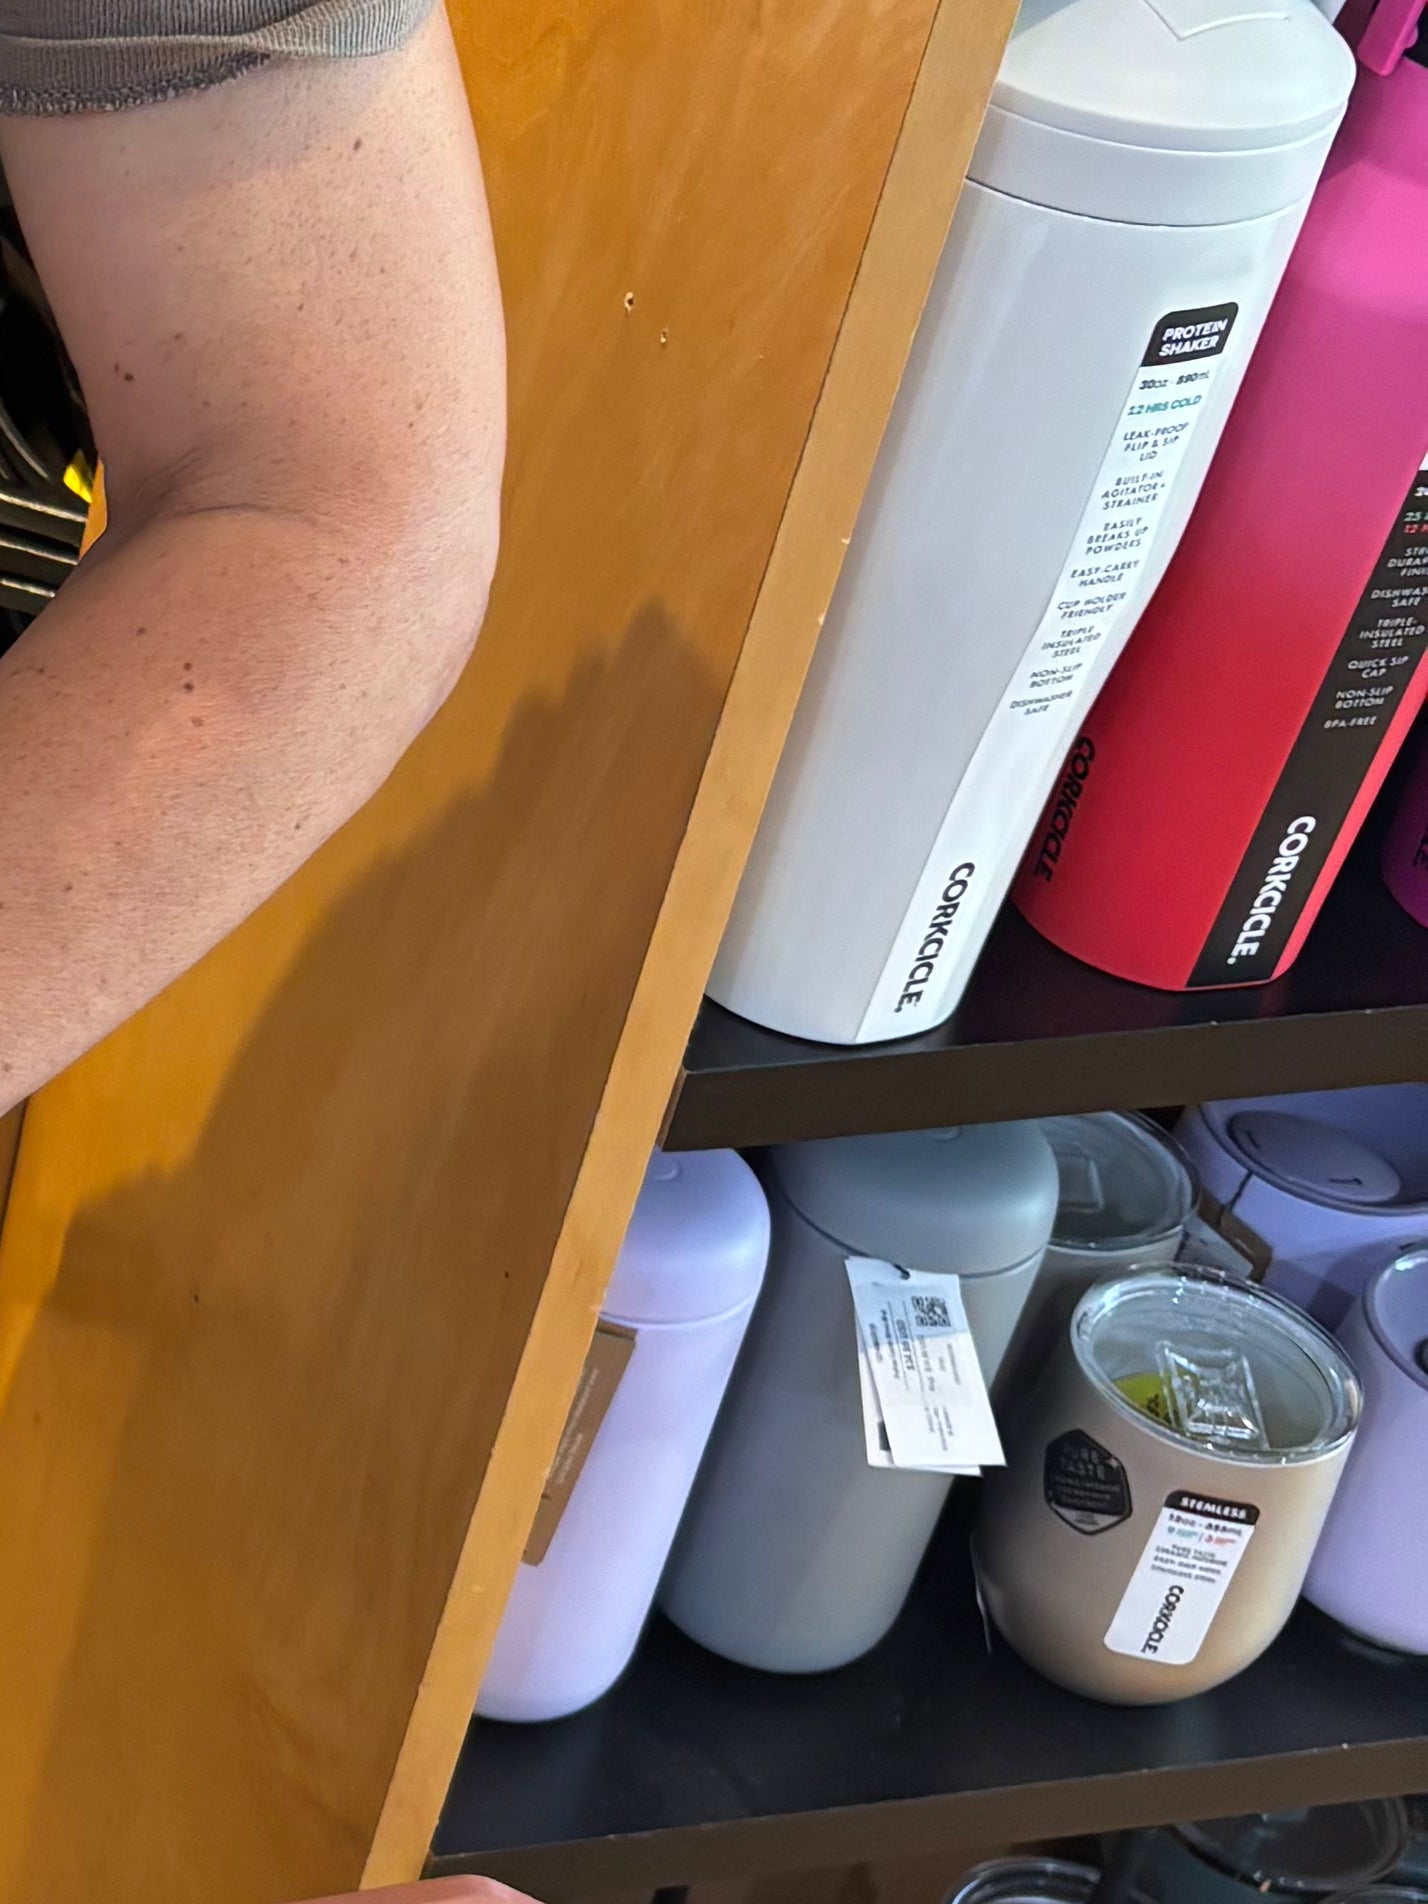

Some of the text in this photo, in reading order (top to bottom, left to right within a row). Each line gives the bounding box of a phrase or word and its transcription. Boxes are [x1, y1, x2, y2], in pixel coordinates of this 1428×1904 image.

[1163, 318, 1228, 342] PROTEIN
[1159, 335, 1220, 357] SHAKER
[1145, 401, 1169, 413] HRS
[1170, 395, 1202, 410] COLD
[1123, 422, 1189, 441] LEAK-PROOF
[1124, 441, 1149, 452] FLIP
[1115, 470, 1164, 486] BUILT-IN
[1102, 493, 1158, 510] STRAINER
[1103, 517, 1142, 531] EASILY
[1087, 529, 1130, 544] BREAKS
[1085, 539, 1142, 555] POWDERS
[1070, 560, 1140, 579] EASY-CARRY
[1078, 573, 1124, 588] HANDLE
[1084, 592, 1127, 607] HOLDER
[1391, 596, 1422, 608] SAFE
[1061, 603, 1114, 620] FRIENDLY
[1359, 624, 1426, 640] INSULATED
[1371, 637, 1404, 649] STEEL
[1348, 658, 1387, 670] QUICK
[1361, 668, 1387, 679] CAP
[1336, 686, 1394, 699] NON-SLIP
[1334, 697, 1384, 710] BOTTOM
[1324, 715, 1378, 729] BPA-FREE
[1225, 814, 1317, 966] CORKCICLE.
[1180, 1496, 1247, 1520] STEMLESS
